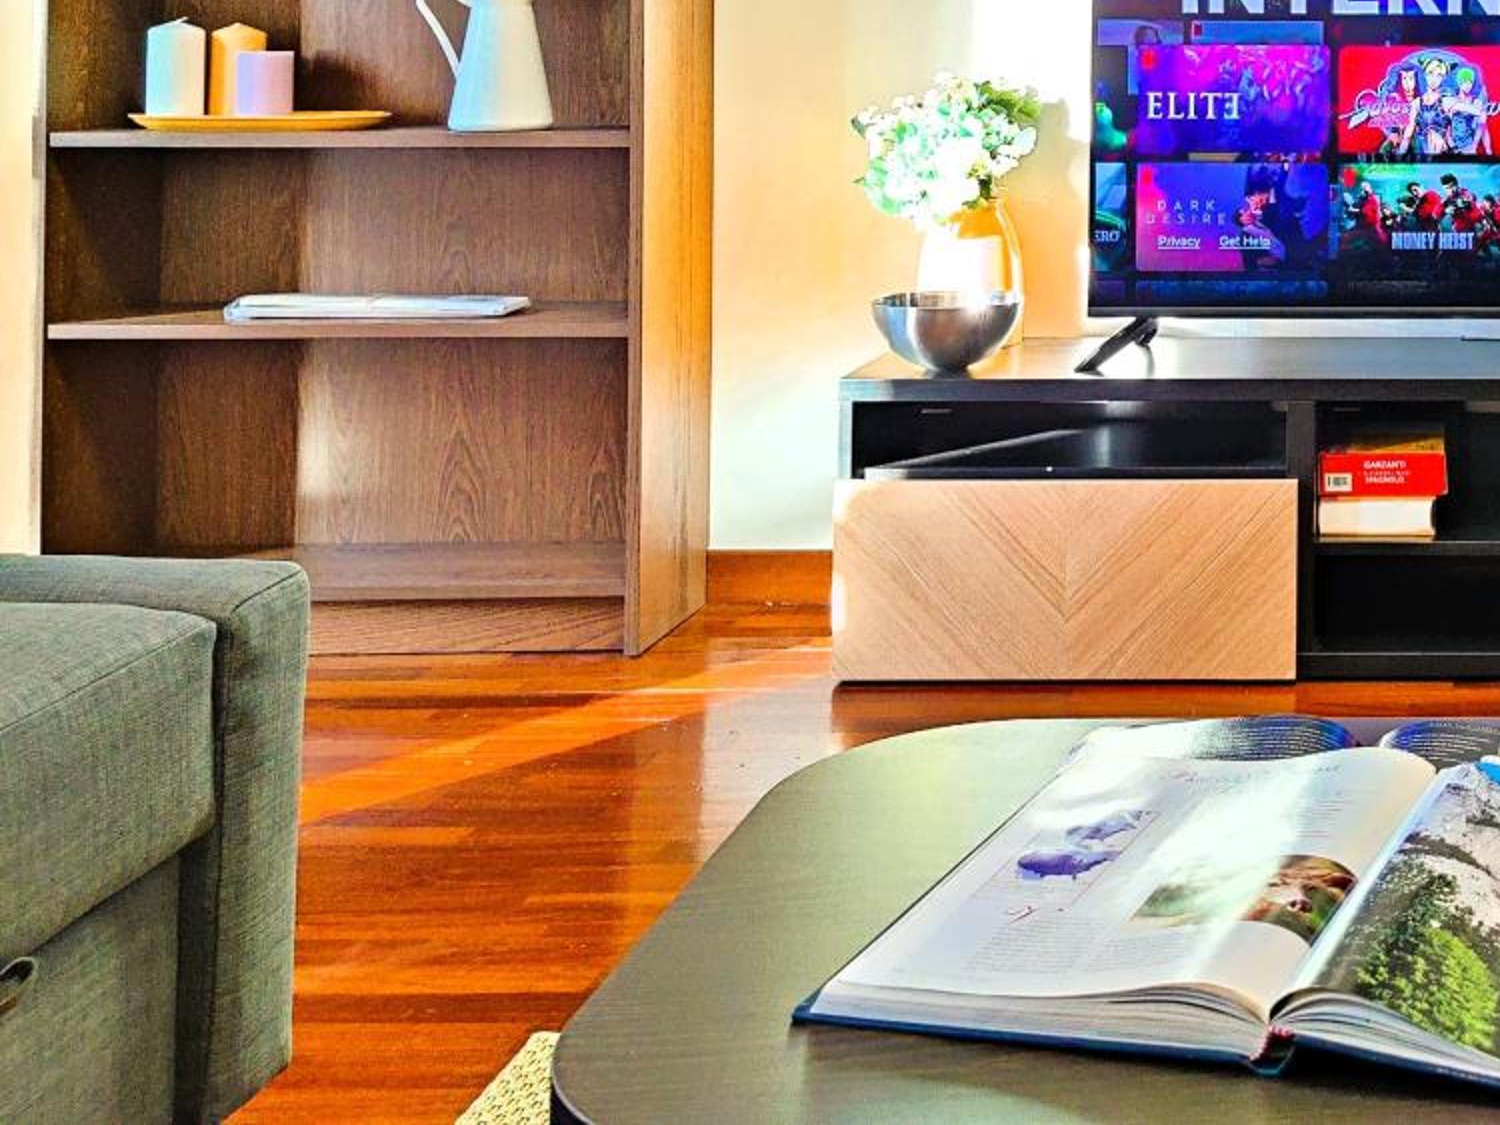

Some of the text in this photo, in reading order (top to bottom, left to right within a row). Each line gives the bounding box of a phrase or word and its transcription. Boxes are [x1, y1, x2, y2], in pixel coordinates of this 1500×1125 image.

[1146, 91, 1242, 120] ELITE
[1157, 198, 1216, 212] DARK
[1146, 212, 1227, 226] DESIRE
[1157, 234, 1201, 249] Privacy
[1219, 235, 1271, 249] Get Help
[1391, 231, 1475, 250] MONEY HEIST
